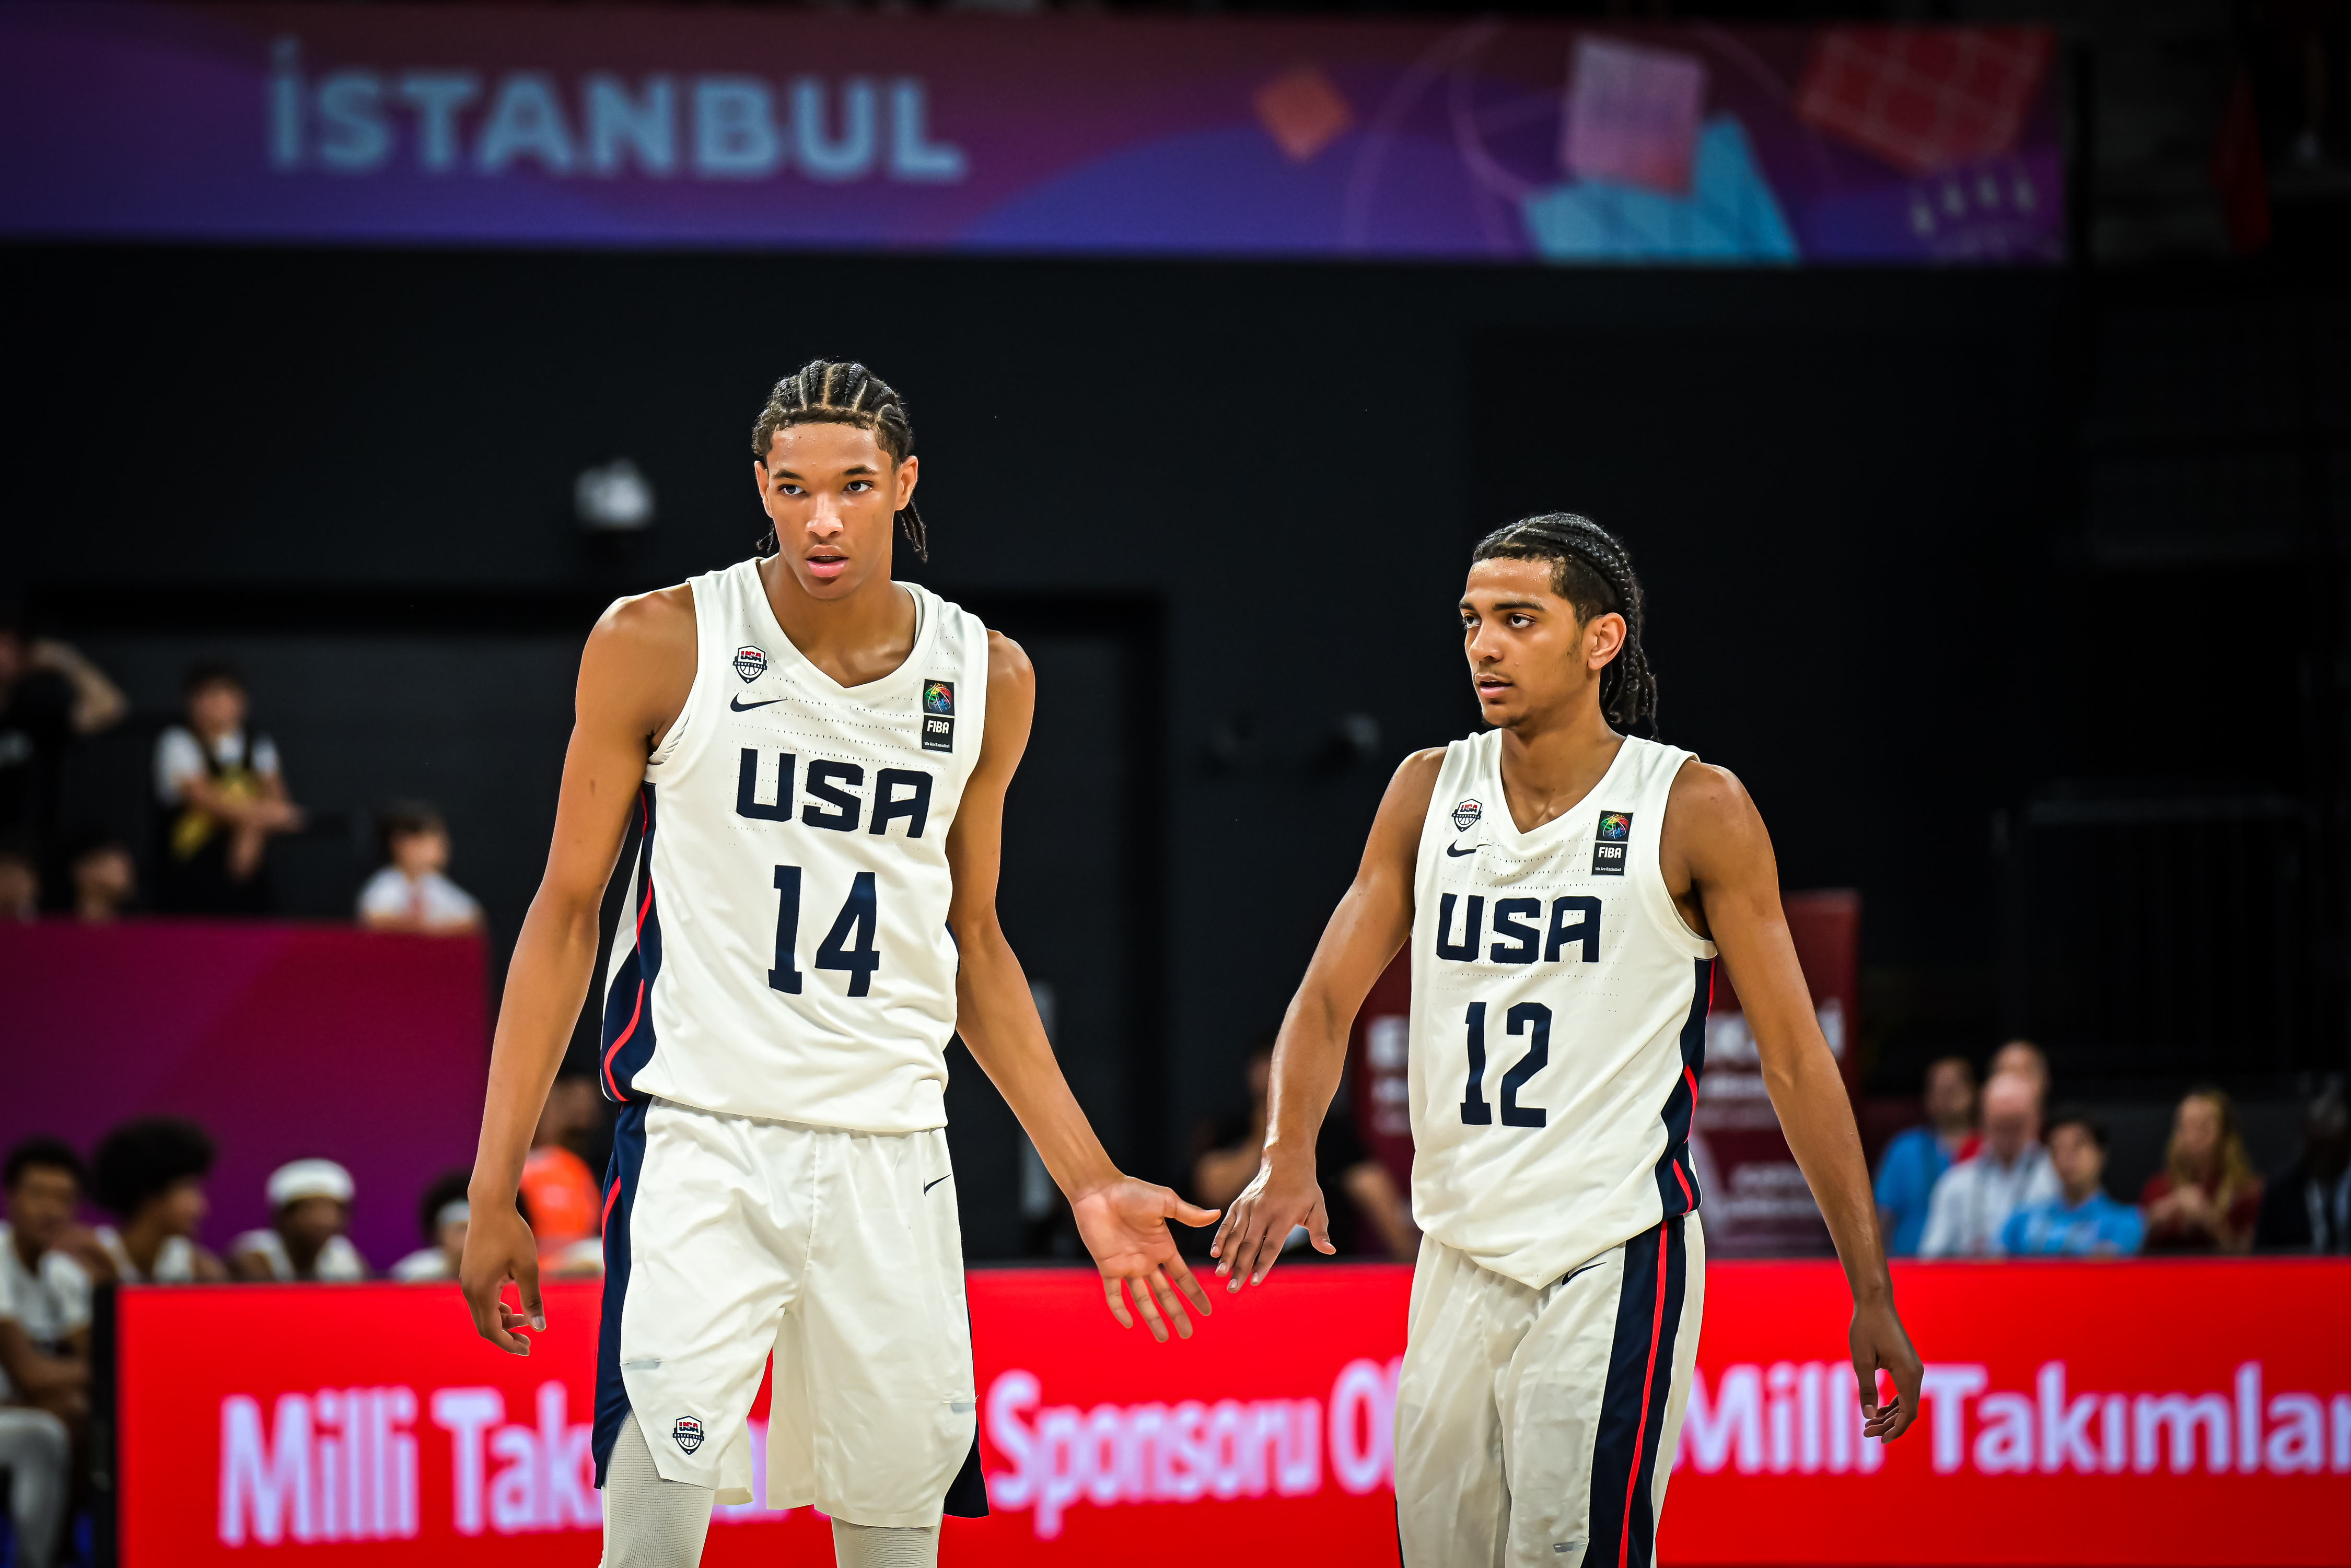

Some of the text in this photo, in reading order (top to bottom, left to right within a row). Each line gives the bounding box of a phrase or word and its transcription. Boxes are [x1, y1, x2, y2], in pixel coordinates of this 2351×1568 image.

[269, 39, 967, 182] İSTANBUL
[740, 651, 762, 662] USA
[927, 720, 949, 734] FIBA
[736, 748, 933, 838] USA
[1460, 804, 1477, 813] USA
[1598, 847, 1622, 859] FIBA
[768, 864, 880, 997] 14
[1436, 893, 1602, 964] USA
[1460, 1001, 1552, 1128] 12
[217, 1384, 418, 1547] Milli
[984, 1368, 1323, 1539] Sponsoru
[679, 1422, 699, 1433] USA
